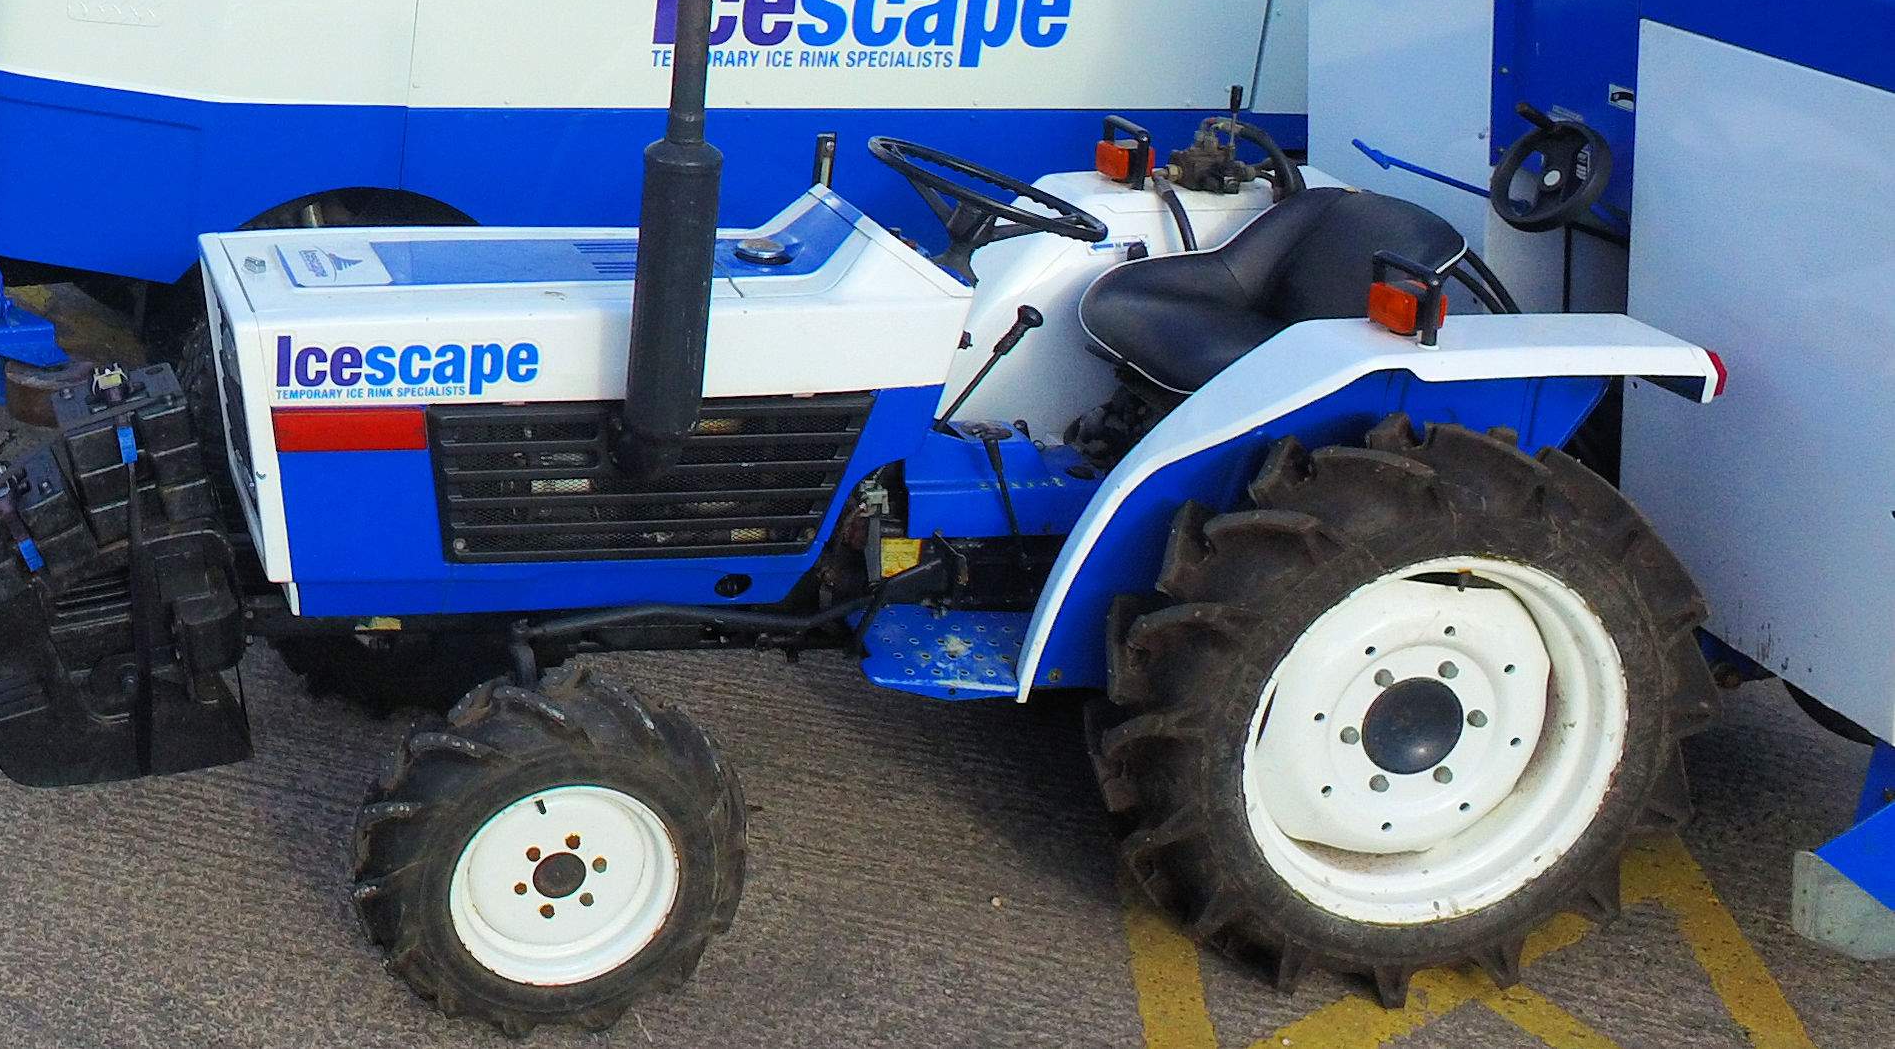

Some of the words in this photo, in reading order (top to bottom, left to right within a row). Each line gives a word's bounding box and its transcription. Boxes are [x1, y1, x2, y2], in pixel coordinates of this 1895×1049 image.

[652, 50, 759, 67] TERARY
[766, 50, 793, 67] ICE
[799, 50, 839, 67] RINK
[845, 50, 954, 68] SPECIALISTS
[276, 335, 539, 395] Icescape
[276, 388, 343, 400] TEMPORARY
[346, 388, 364, 399] ICE
[368, 388, 393, 398] RINK
[397, 386, 466, 398] SPECIALISTS
